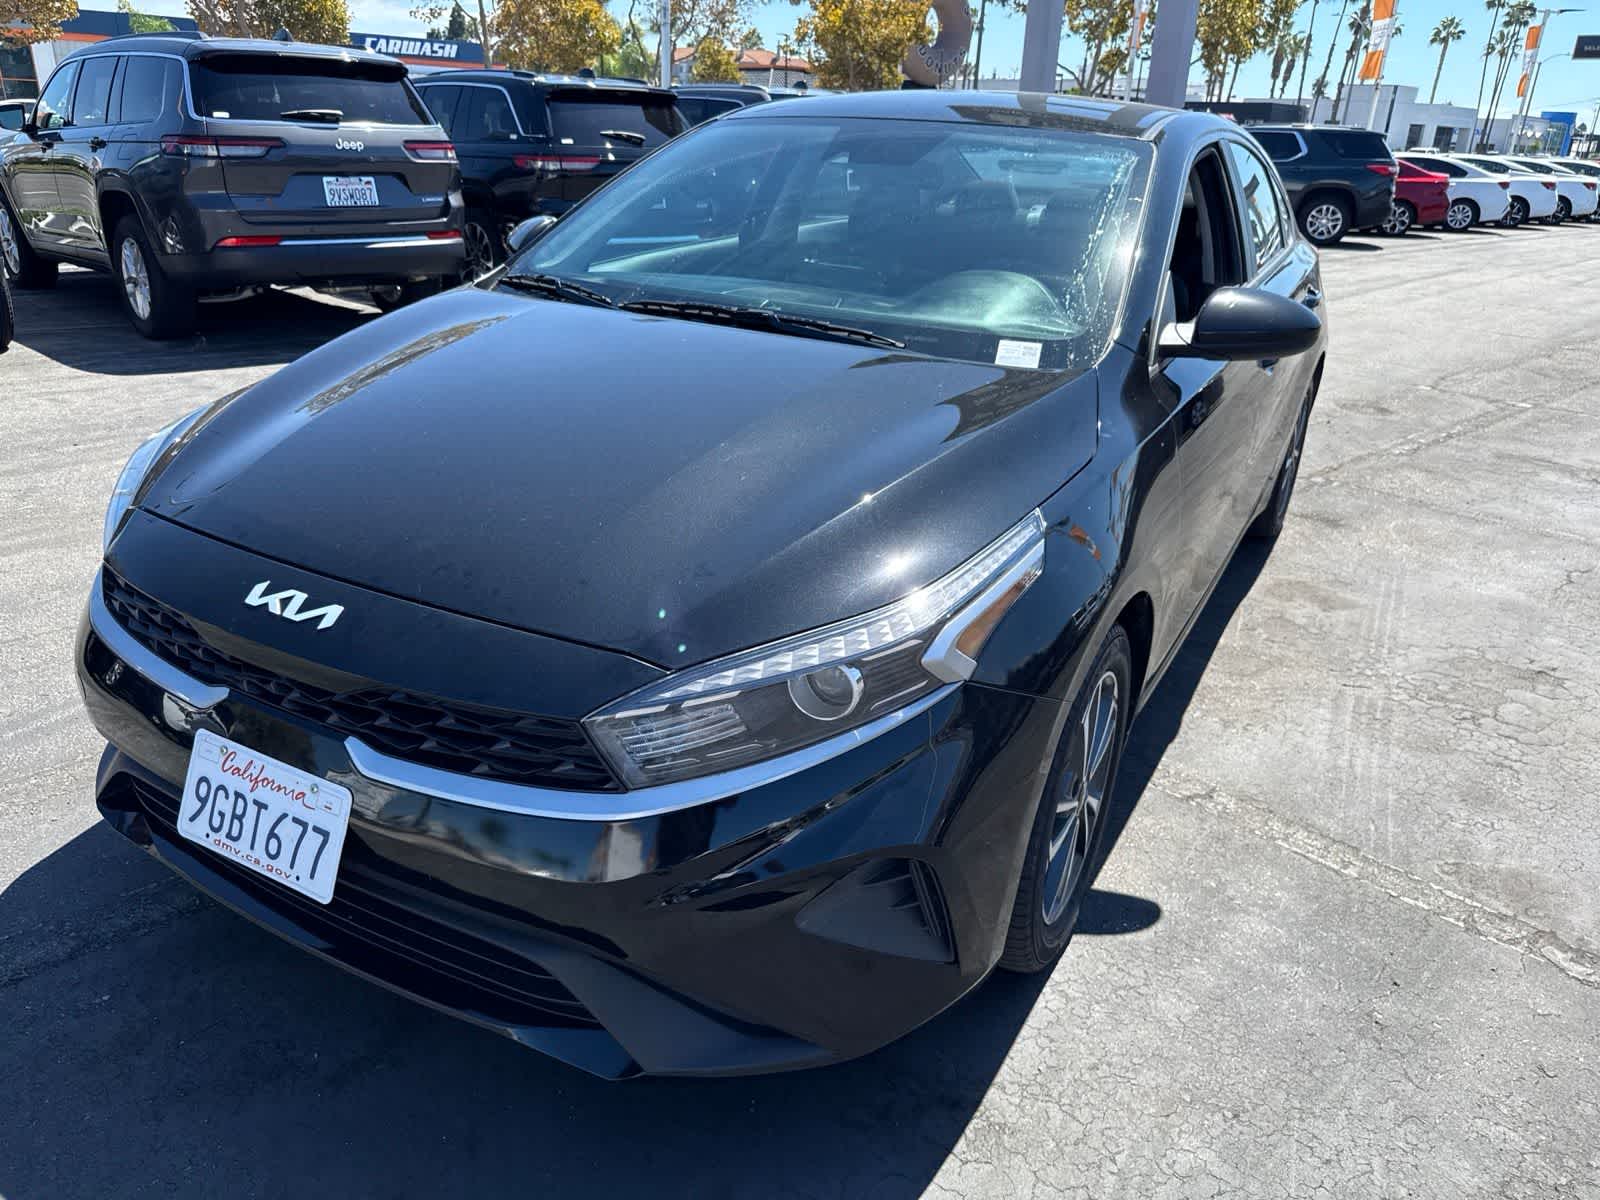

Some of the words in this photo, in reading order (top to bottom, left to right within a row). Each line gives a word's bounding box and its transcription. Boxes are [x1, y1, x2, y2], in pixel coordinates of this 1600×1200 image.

[365, 37, 458, 58] CARWASH
[336, 138, 364, 152] Jeep
[244, 580, 345, 630] KIA
[221, 751, 315, 810] California
[188, 775, 331, 880] 9GBT677
[213, 837, 293, 881] dmv.ca.gov
